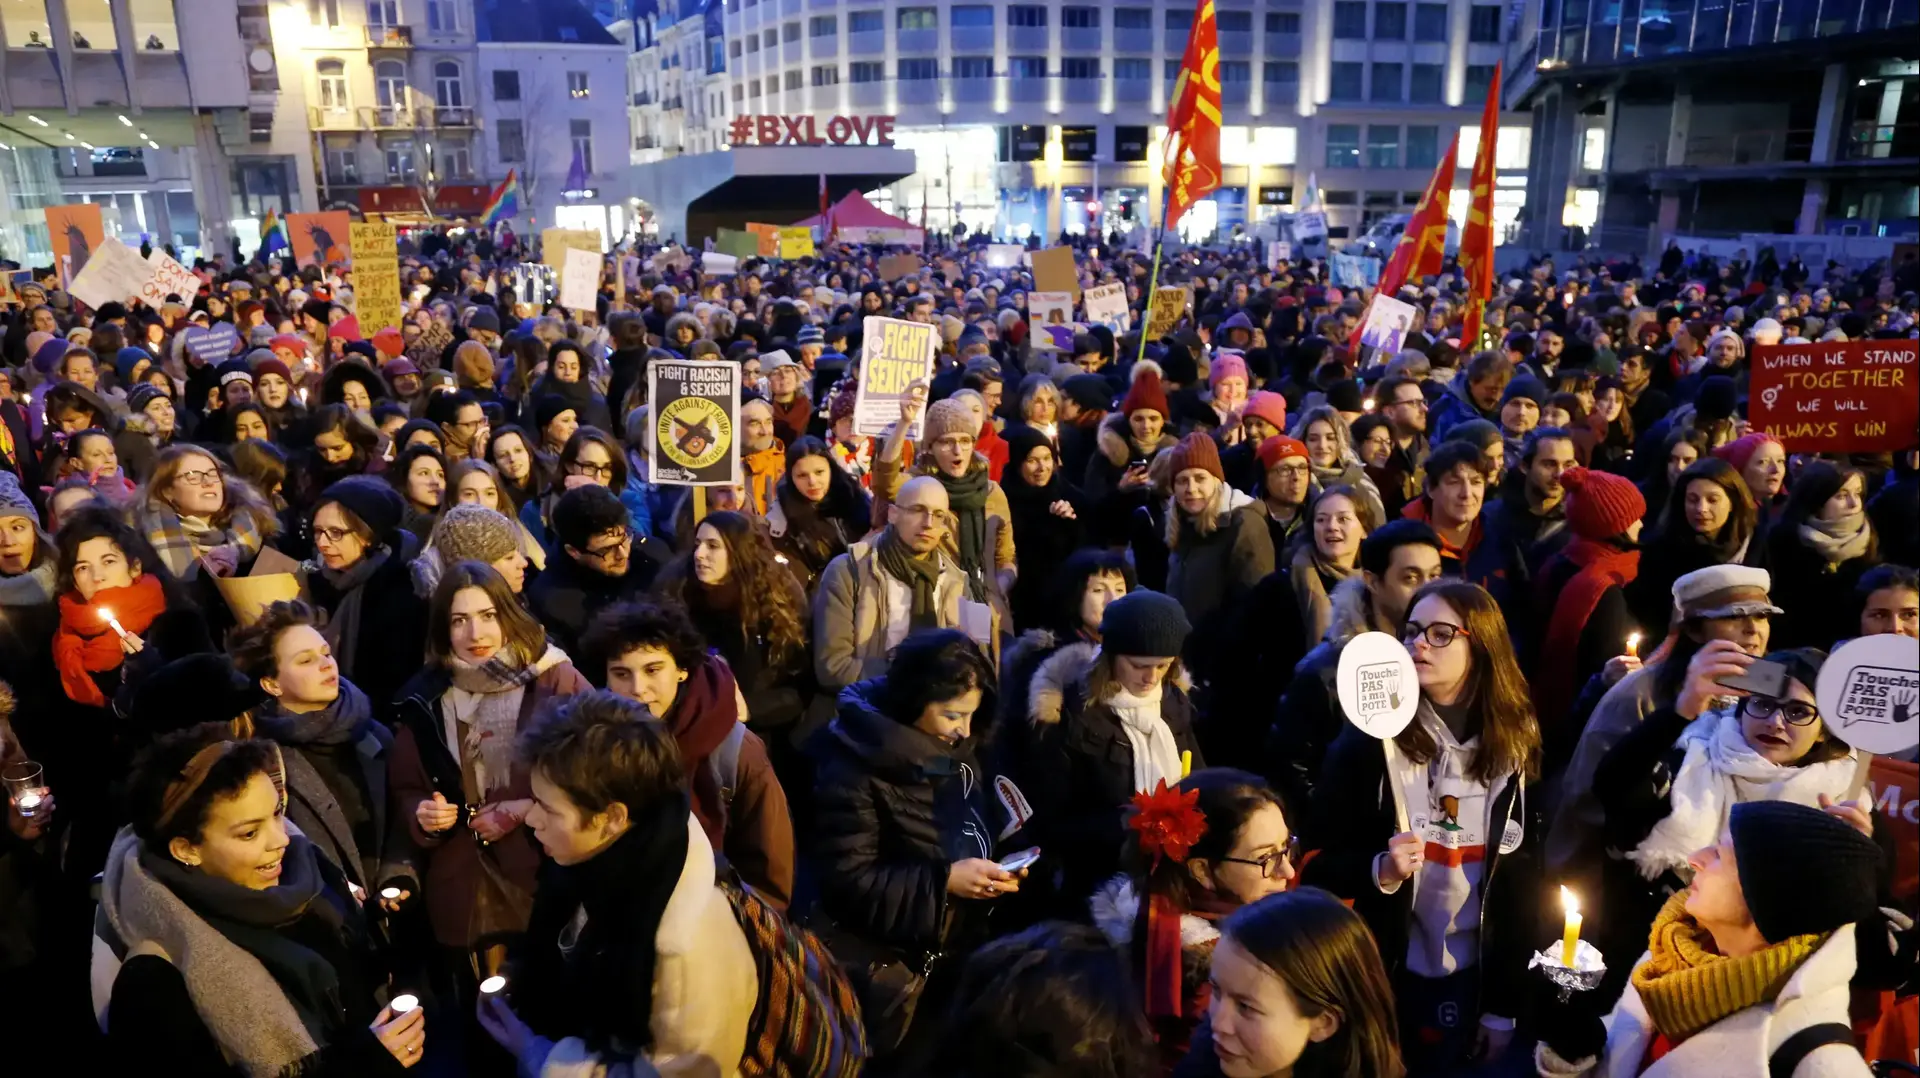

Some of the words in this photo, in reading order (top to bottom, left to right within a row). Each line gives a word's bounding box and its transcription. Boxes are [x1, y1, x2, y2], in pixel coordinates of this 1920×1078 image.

[728, 114, 896, 145] #BXLOVE
[353, 227, 370, 238] WE
[364, 239, 387, 250] NOT
[883, 323, 929, 361] FIGHT
[1763, 354, 1811, 369] WHEN
[1825, 351, 1846, 365] WE
[1864, 350, 1916, 365] STAND
[659, 366, 689, 381] FIGHT
[690, 367, 731, 381] RACISM
[1784, 368, 1905, 389] TOGETHER
[680, 382, 688, 395] &
[690, 382, 730, 396] SEXISM
[1796, 398, 1821, 412] WE
[660, 409, 675, 434] UNITE
[674, 399, 712, 412] AGAINST
[710, 406, 729, 436] TRUMP
[1764, 422, 1838, 439] ALWAYS
[1361, 668, 1399, 680] Touche
[1857, 672, 1919, 688] Touche
[1361, 680, 1384, 692] PAS
[1851, 683, 1890, 697] PAS
[1369, 691, 1385, 700] ma
[1859, 697, 1886, 707] ma
[1362, 700, 1387, 711] POTE
[1844, 704, 1887, 718] POTE
